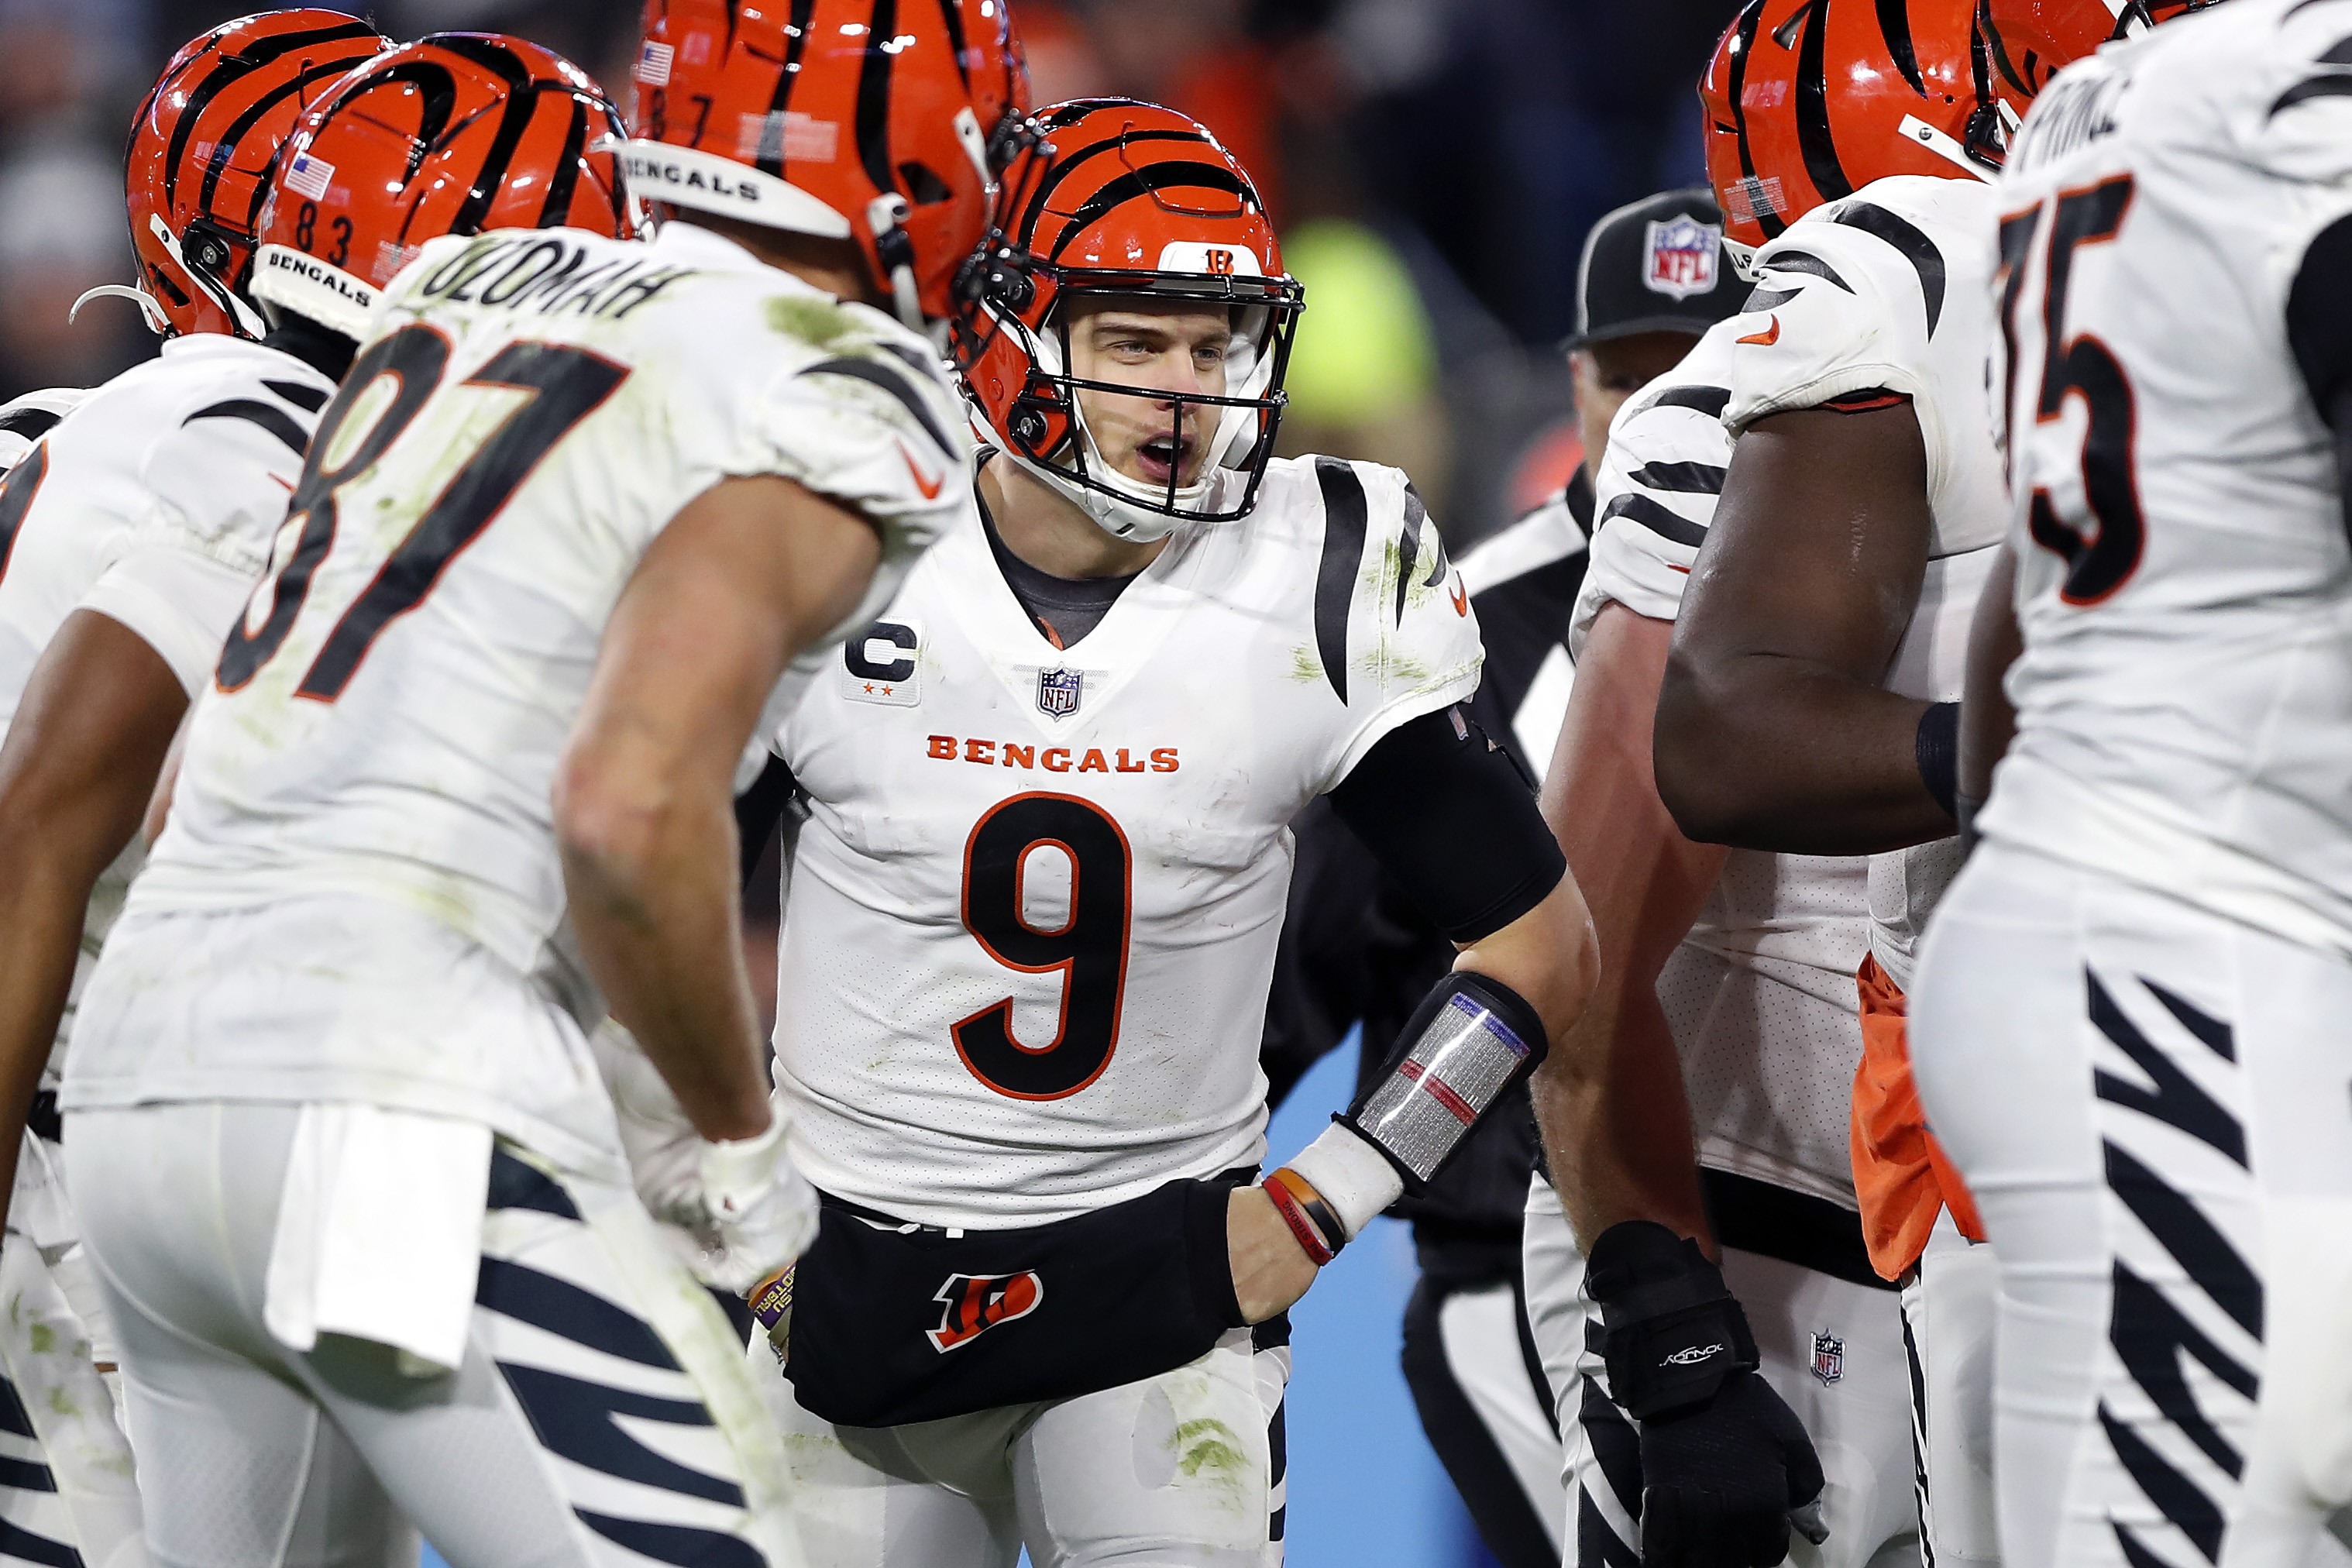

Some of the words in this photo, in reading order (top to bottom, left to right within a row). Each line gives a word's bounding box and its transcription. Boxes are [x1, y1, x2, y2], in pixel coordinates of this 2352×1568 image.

[296, 200, 354, 267] 83
[269, 252, 372, 308] BENGALS
[1654, 248, 1709, 285] NFL
[215, 321, 634, 704] 87
[844, 621, 918, 683] C
[1043, 688, 1075, 711] NFL
[925, 734, 1180, 773] BENGALS
[950, 790, 1133, 1102] 9
[754, 1266, 796, 1317] OTBALL
[772, 1285, 793, 1314] SU
[1817, 1352, 1841, 1376] NFL
